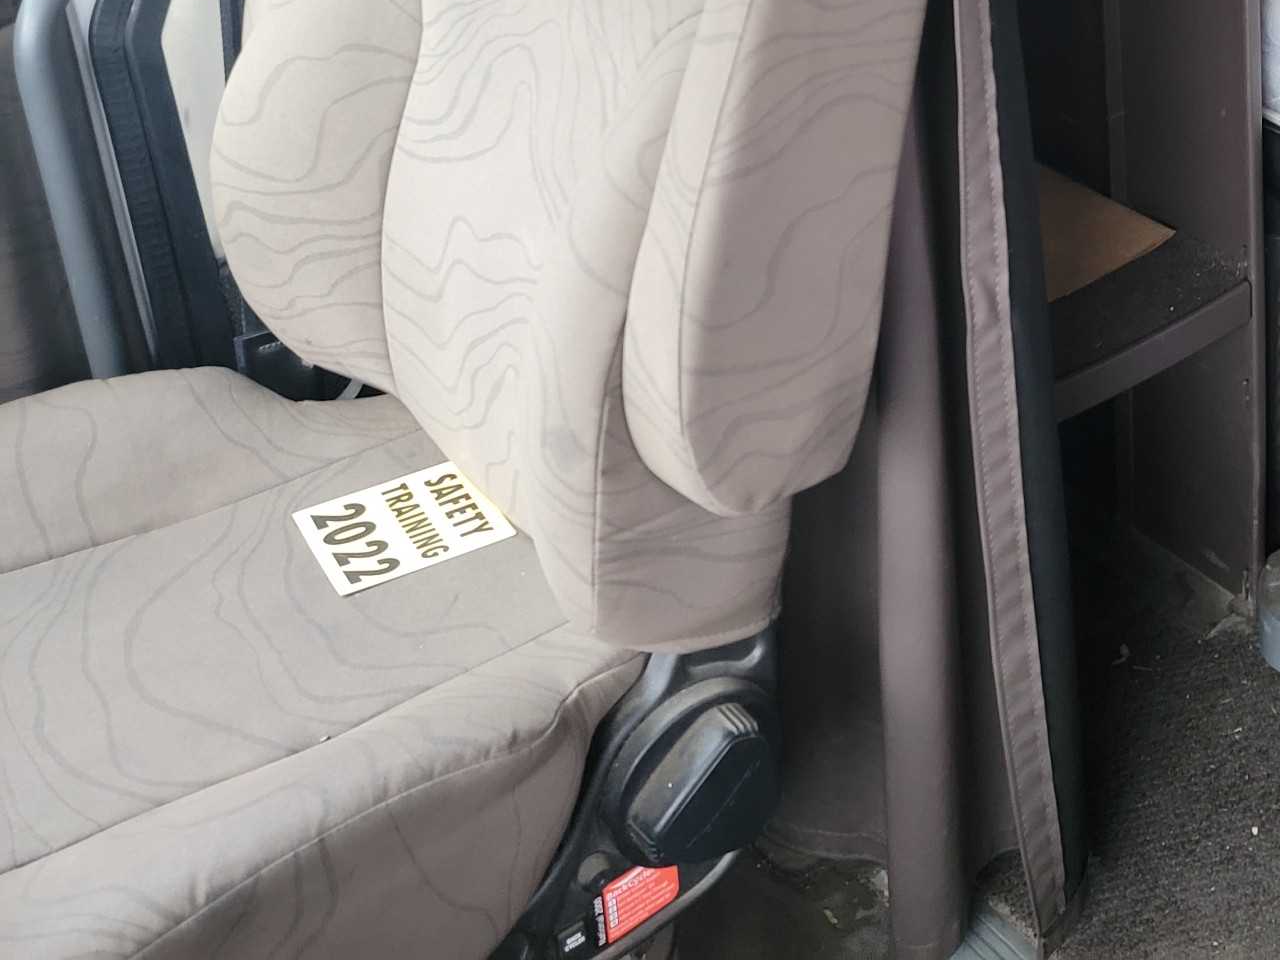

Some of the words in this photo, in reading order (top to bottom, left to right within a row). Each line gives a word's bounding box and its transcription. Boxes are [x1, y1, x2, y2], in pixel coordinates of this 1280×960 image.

[310, 502, 400, 584] 2022
[381, 482, 450, 559] TRAINING
[424, 473, 494, 538] SAFETY
